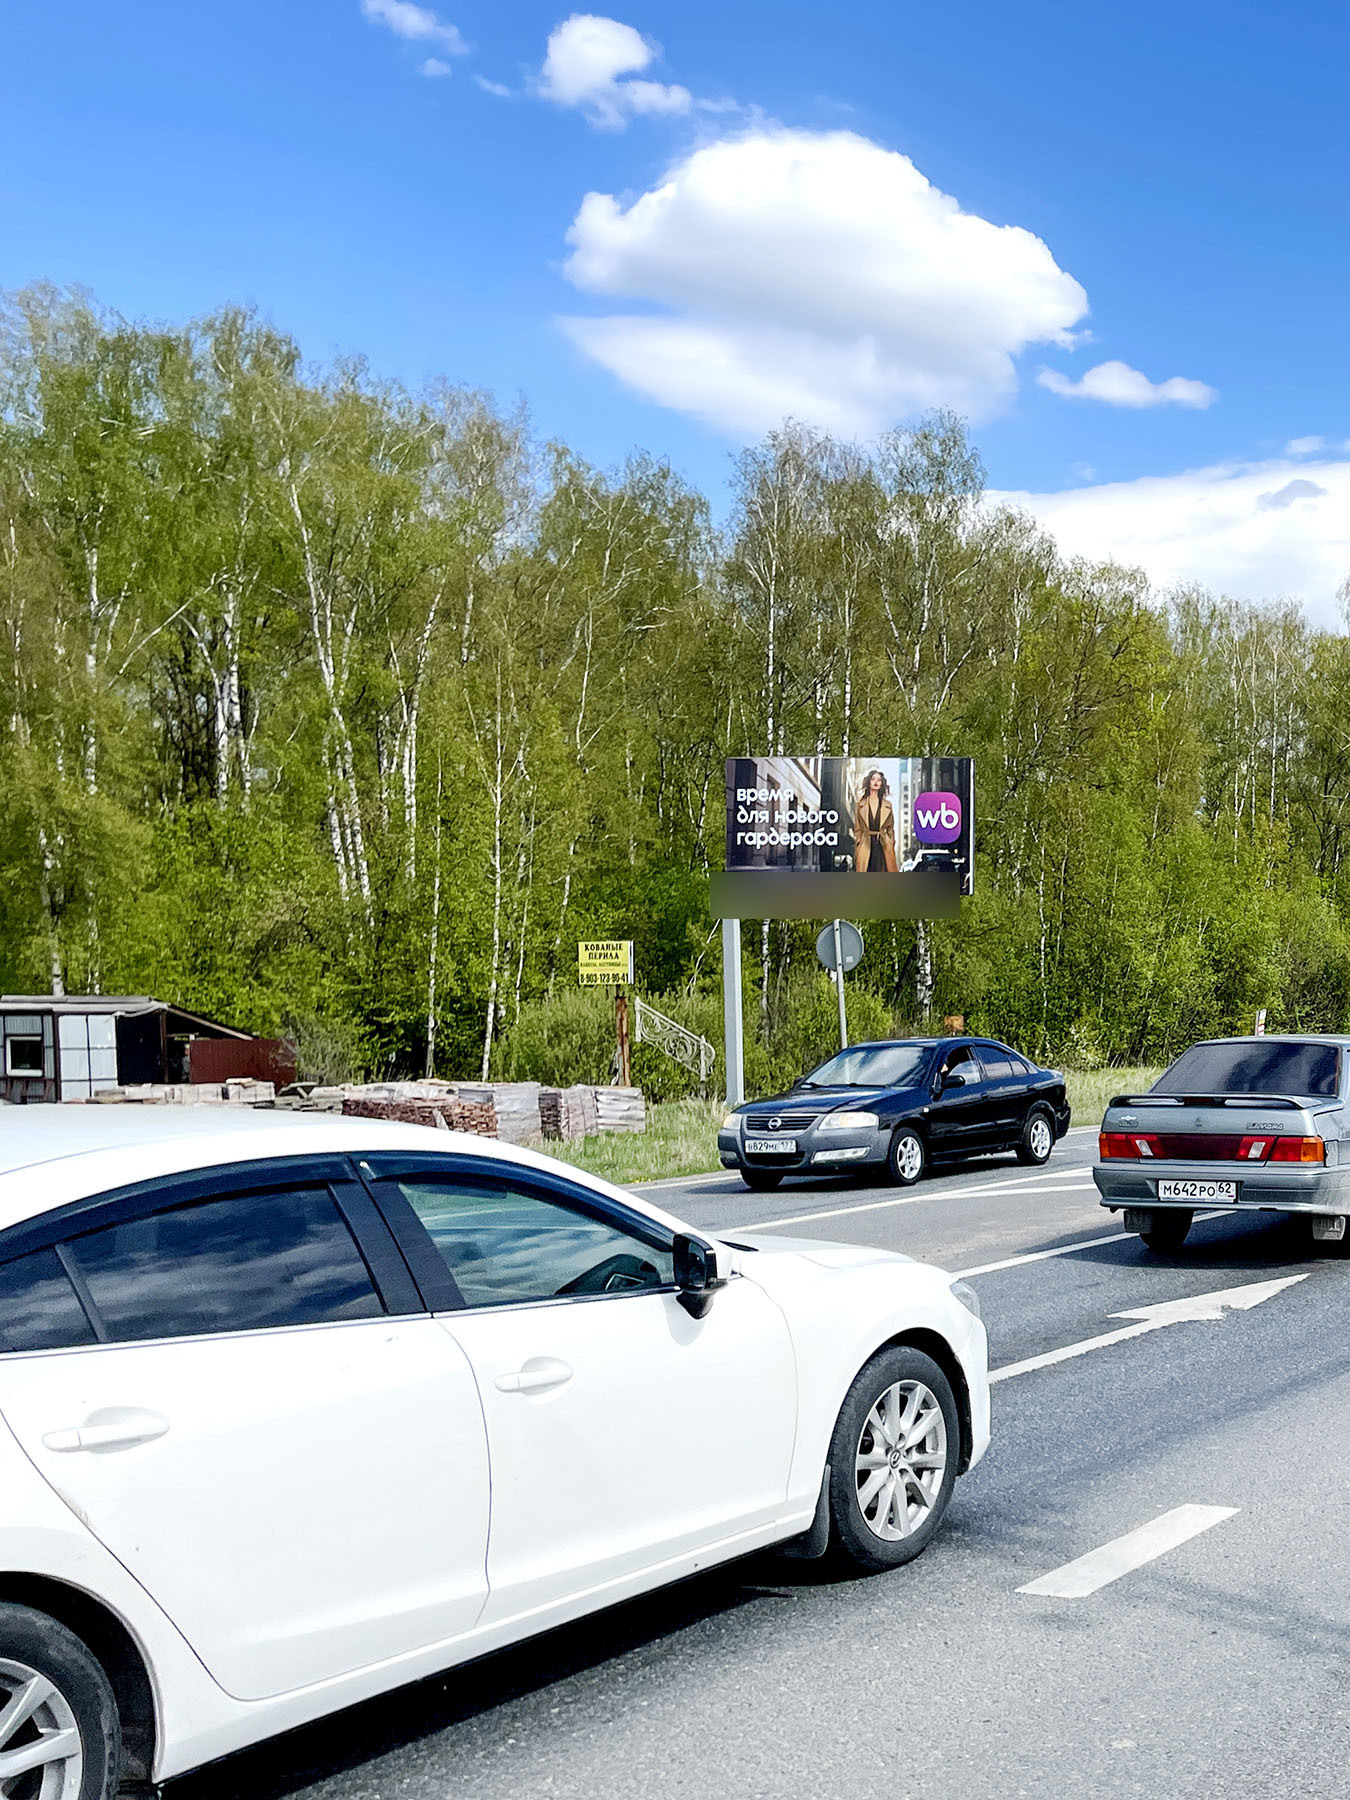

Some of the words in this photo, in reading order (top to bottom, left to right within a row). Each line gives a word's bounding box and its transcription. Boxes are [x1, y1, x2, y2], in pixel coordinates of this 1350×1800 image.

[736, 787, 795, 806] время
[736, 805, 770, 824] для
[774, 809, 839, 824] нового
[916, 802, 960, 829] wb
[736, 826, 839, 850] гардероба
[588, 952, 619, 960] ПЕРИЛА
[1218, 1182, 1232, 1194] 62
